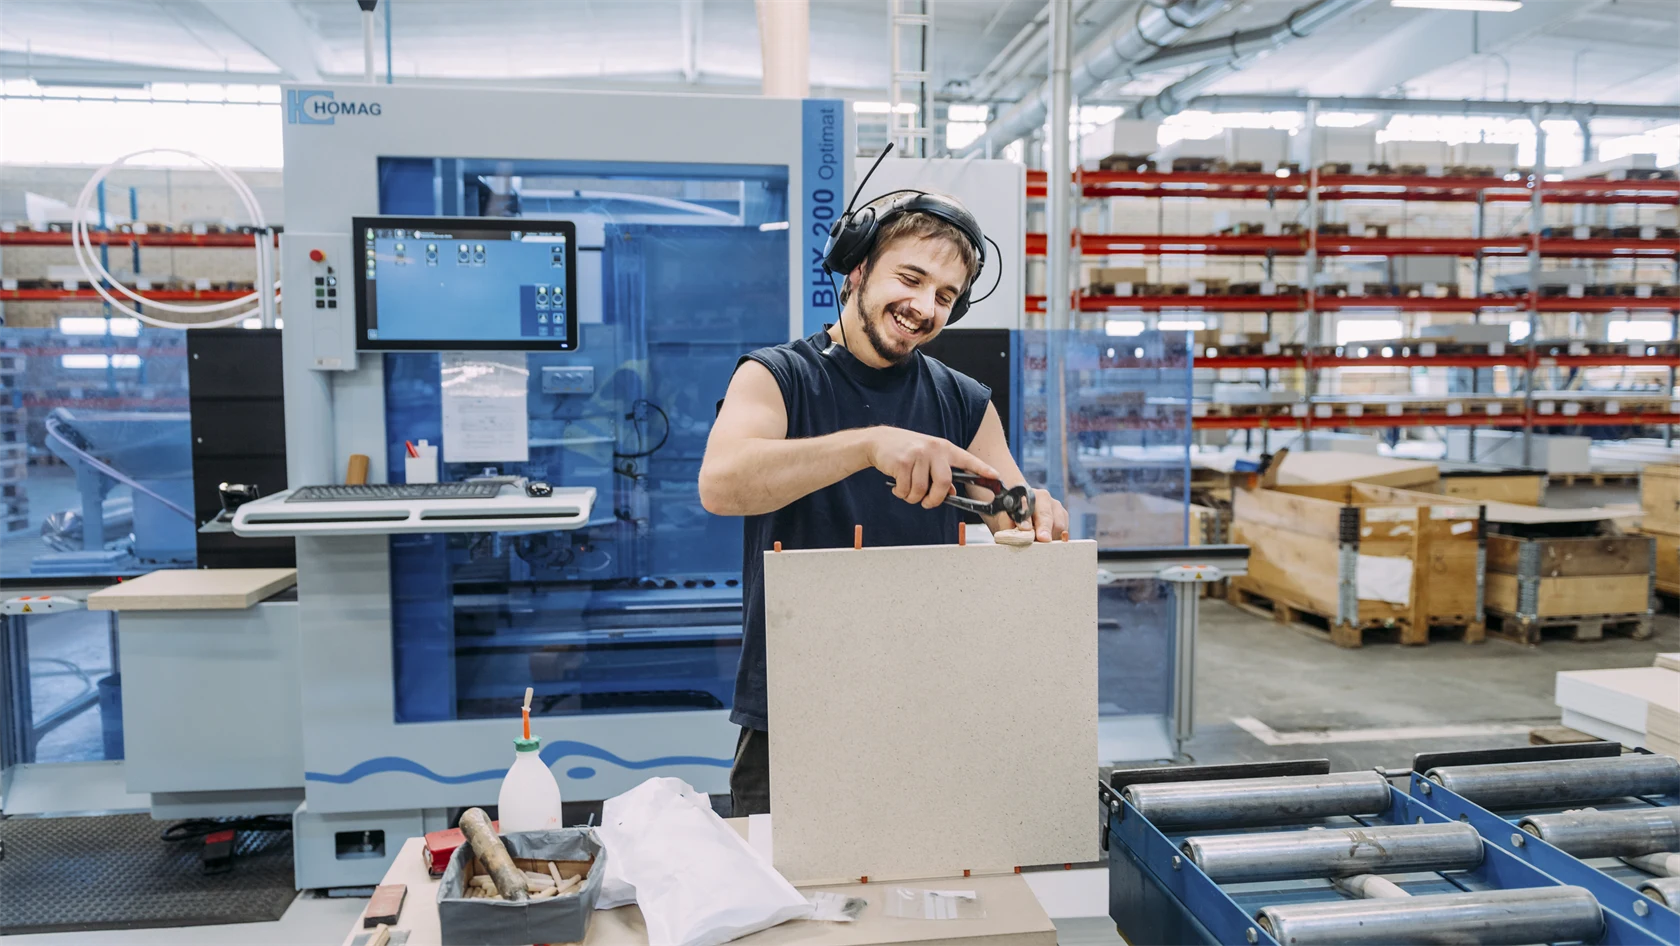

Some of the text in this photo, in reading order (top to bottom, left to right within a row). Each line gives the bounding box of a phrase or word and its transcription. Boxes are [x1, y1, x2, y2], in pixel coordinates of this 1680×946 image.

[314, 101, 382, 116] HOMAG
[818, 108, 837, 180] Optimat
[812, 189, 835, 237] 200
